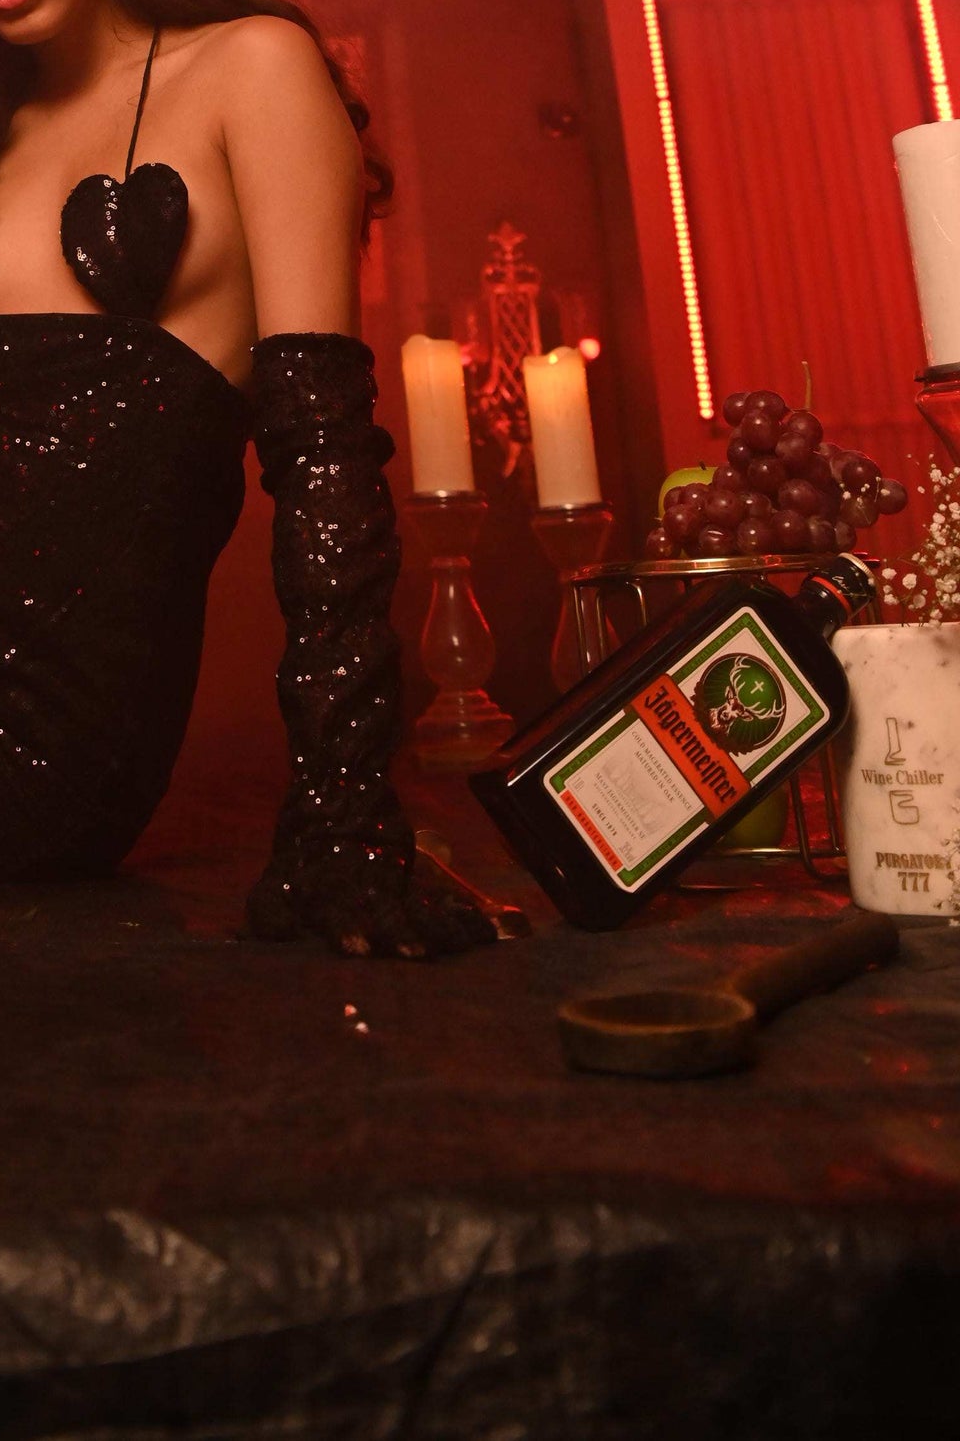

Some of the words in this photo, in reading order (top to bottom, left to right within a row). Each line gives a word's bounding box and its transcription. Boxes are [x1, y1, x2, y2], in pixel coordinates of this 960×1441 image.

[862, 769, 893, 786] Wine
[896, 770, 944, 786] Chiller
[898, 872, 929, 892] 777
